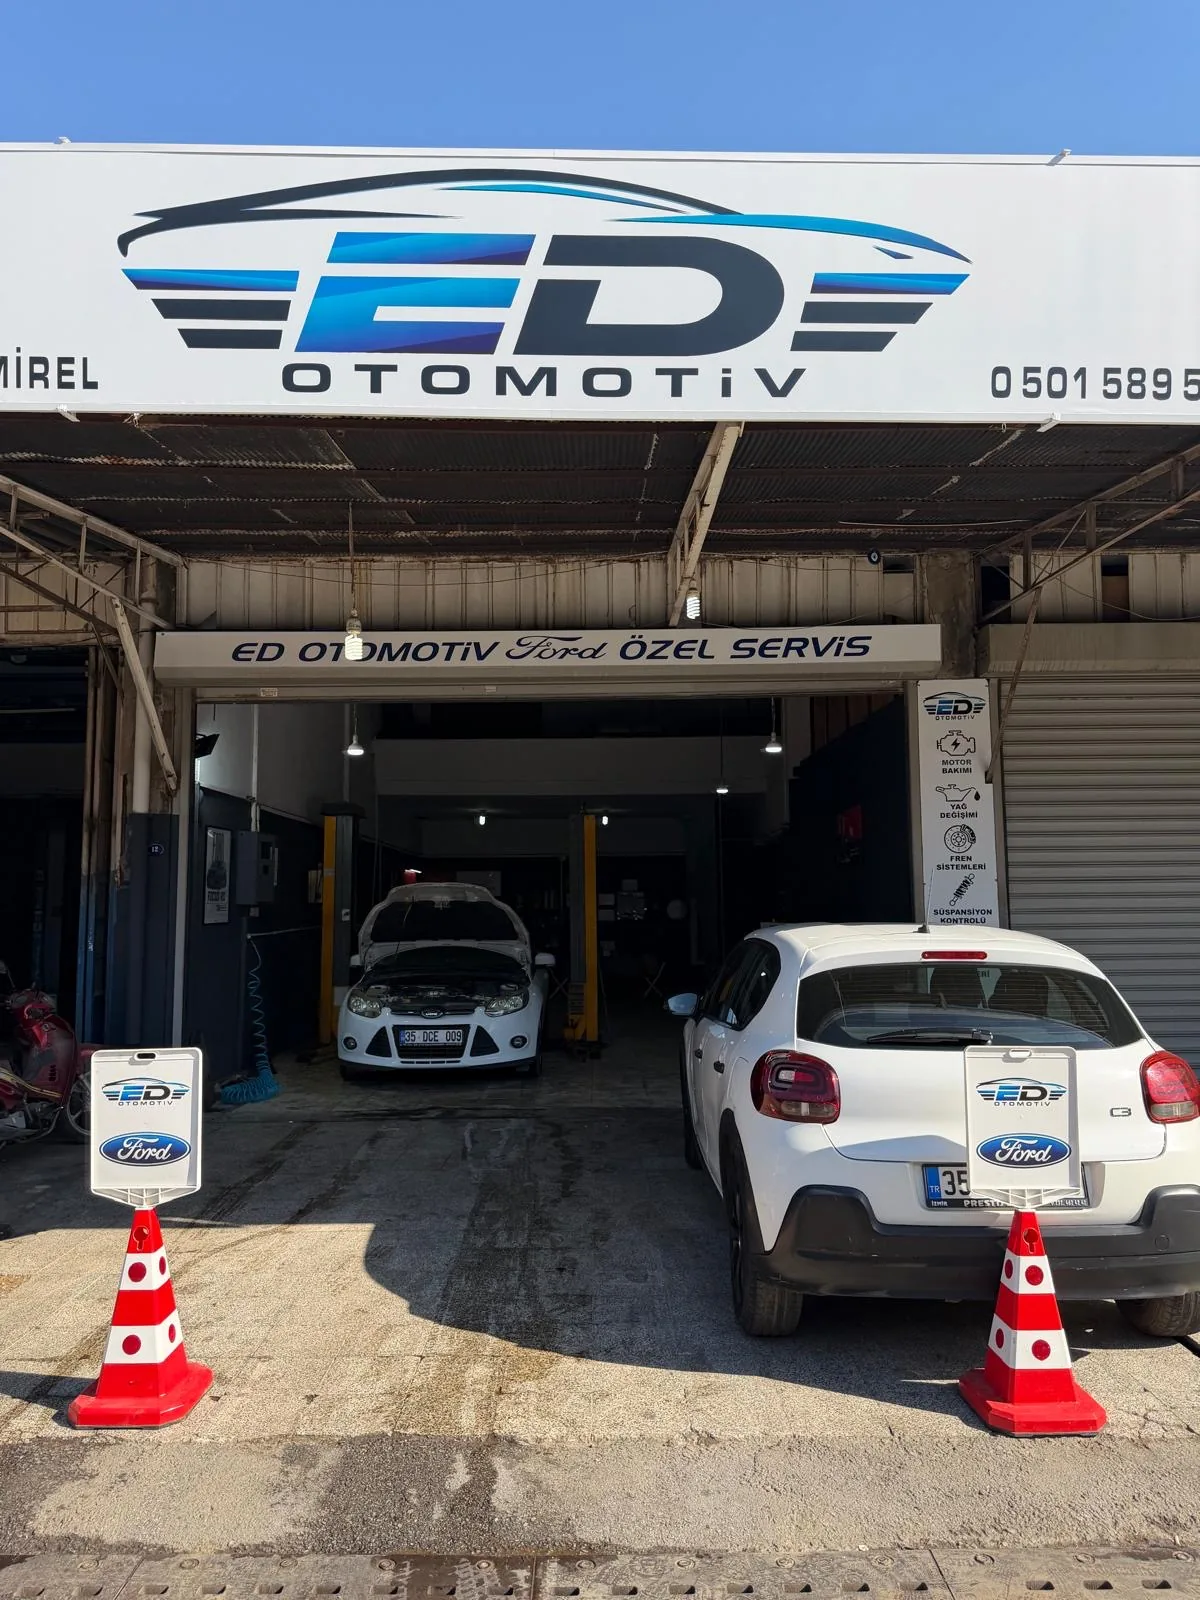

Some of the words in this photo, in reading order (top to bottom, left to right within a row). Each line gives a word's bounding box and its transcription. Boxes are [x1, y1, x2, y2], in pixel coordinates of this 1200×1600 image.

[294, 231, 785, 357] ED
[991, 366, 1012, 399] 0
[1022, 366, 1087, 400] 501
[1102, 367, 1172, 401] 589
[231, 642, 285, 662] ED
[505, 635, 609, 661] Ford
[619, 634, 716, 661] ÖZEL
[936, 699, 973, 715] ED
[940, 811, 978, 820] DEĞİŞİMİ
[936, 863, 987, 871] SİSTEMLERİ
[933, 908, 993, 916] SÜSPANSİYON
[940, 916, 987, 924] KONTROLÜ
[405, 1031, 416, 1042] 35
[422, 1031, 439, 1042] DCE
[445, 1030, 462, 1042] 009
[120, 1085, 171, 1101] ED
[995, 1085, 1048, 1101] ED
[117, 1136, 173, 1160] Ford
[995, 1138, 1053, 1162] Ford
[929, 1185, 940, 1193] TR
[942, 1170, 971, 1196] 35
